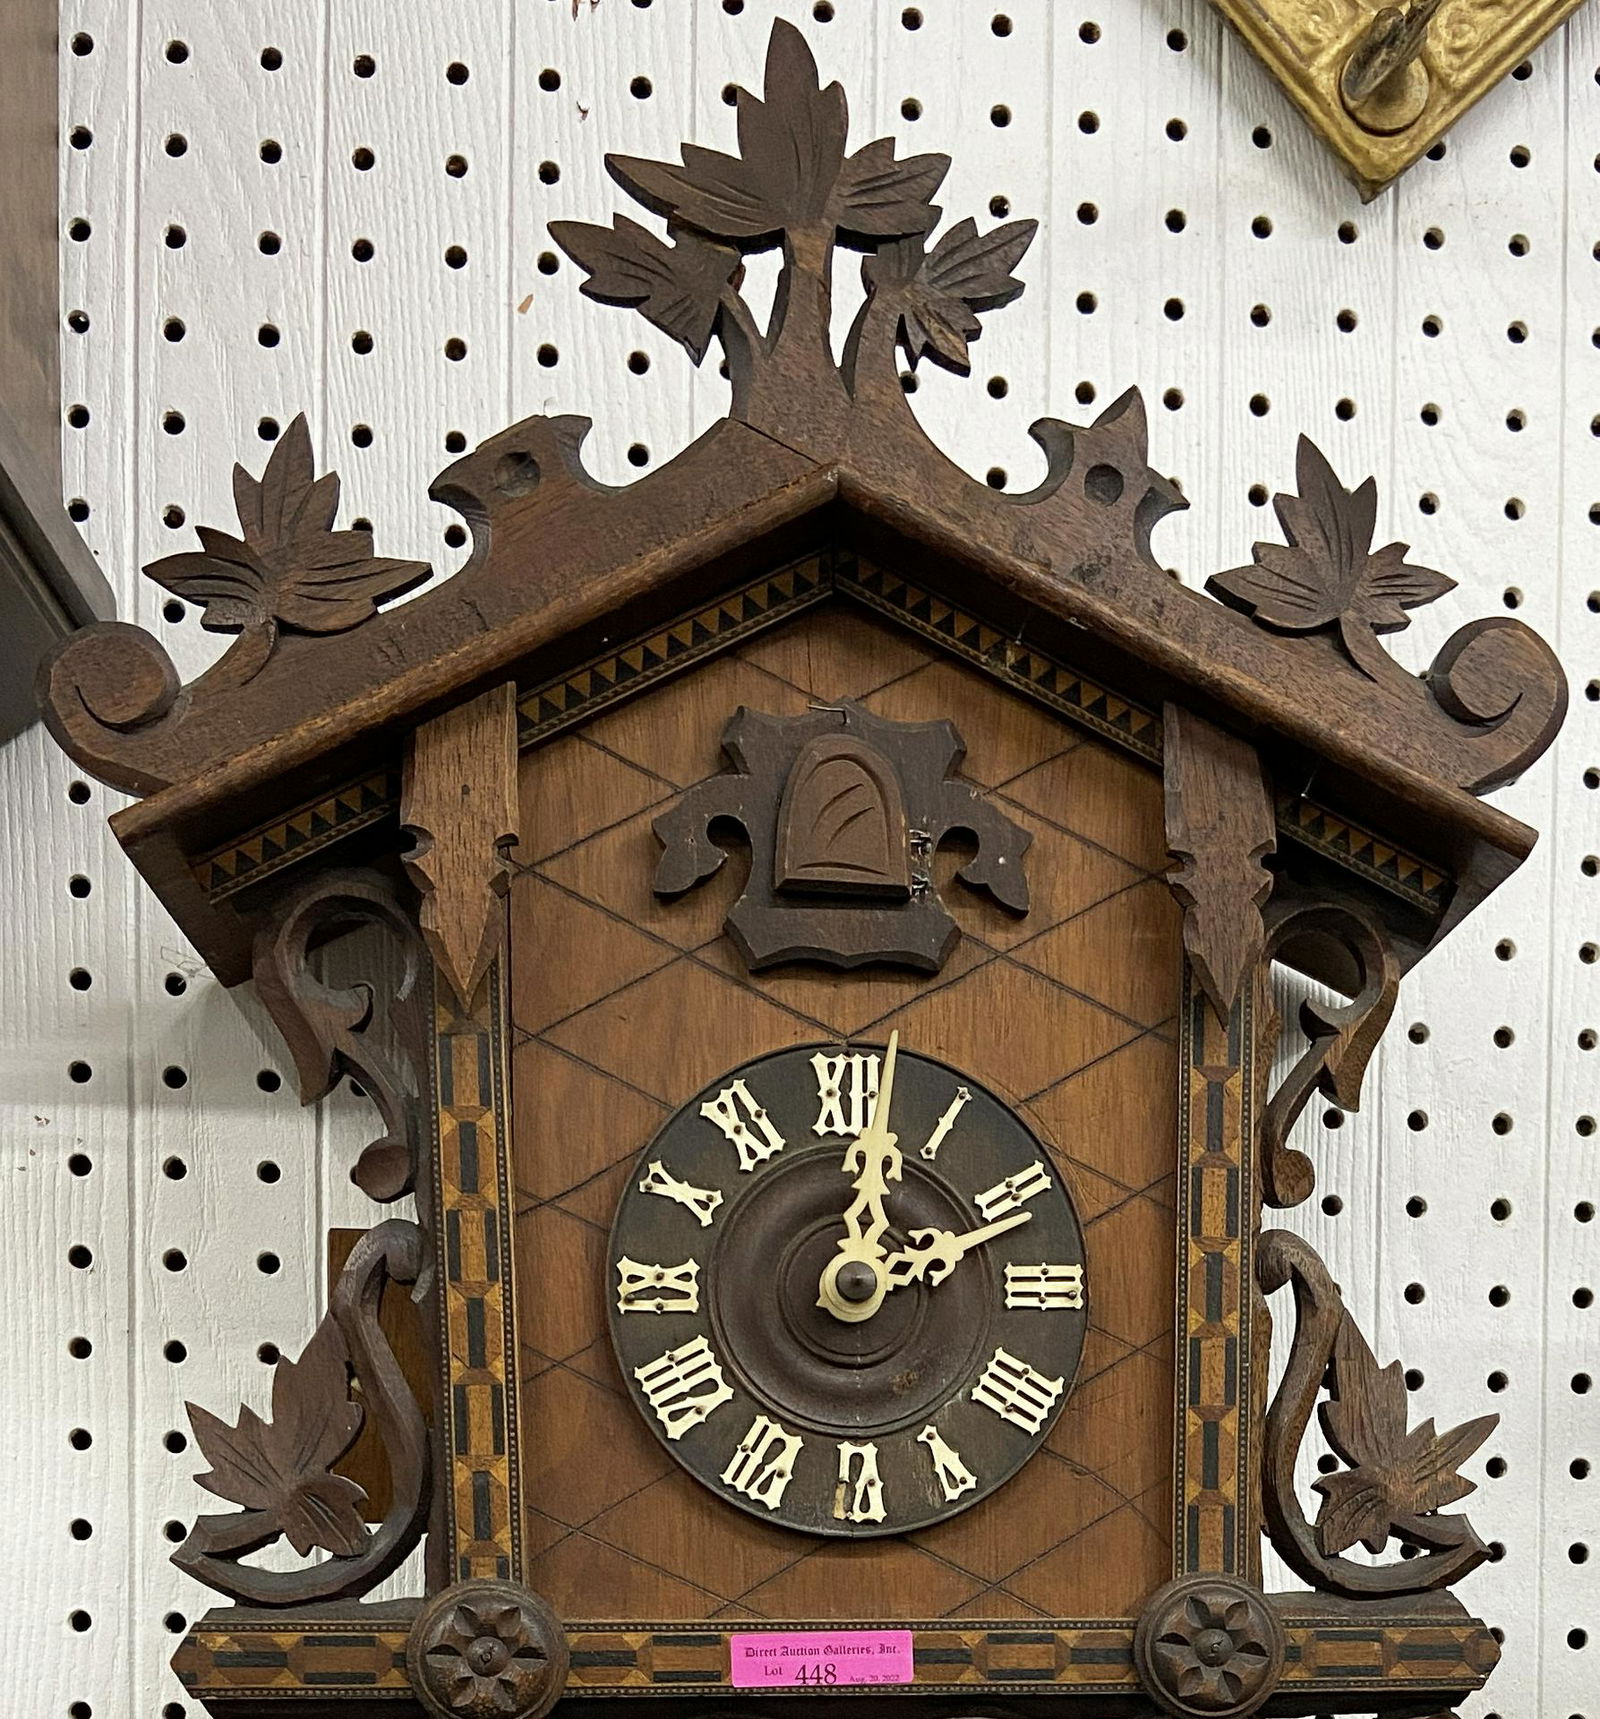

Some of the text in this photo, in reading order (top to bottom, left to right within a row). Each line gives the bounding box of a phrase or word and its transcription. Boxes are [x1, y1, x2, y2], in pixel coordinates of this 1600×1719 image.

[700, 1079, 786, 1172] XI
[809, 1052, 881, 1137] XII
[920, 1086, 973, 1160] I
[639, 1160, 724, 1227] X
[974, 1159, 1053, 1221] II
[616, 1255, 700, 1314] IX
[1003, 1262, 1085, 1310] III
[633, 1334, 735, 1440] VIII
[971, 1347, 1065, 1436] IIII
[719, 1414, 804, 1511] VII
[832, 1440, 889, 1523] VI
[917, 1424, 978, 1502] V
[744, 1643, 901, 1657] Direct Auction Galleries, Inc.
[764, 1663, 837, 1684] Lot 448
[882, 1673, 900, 1682] 2022
